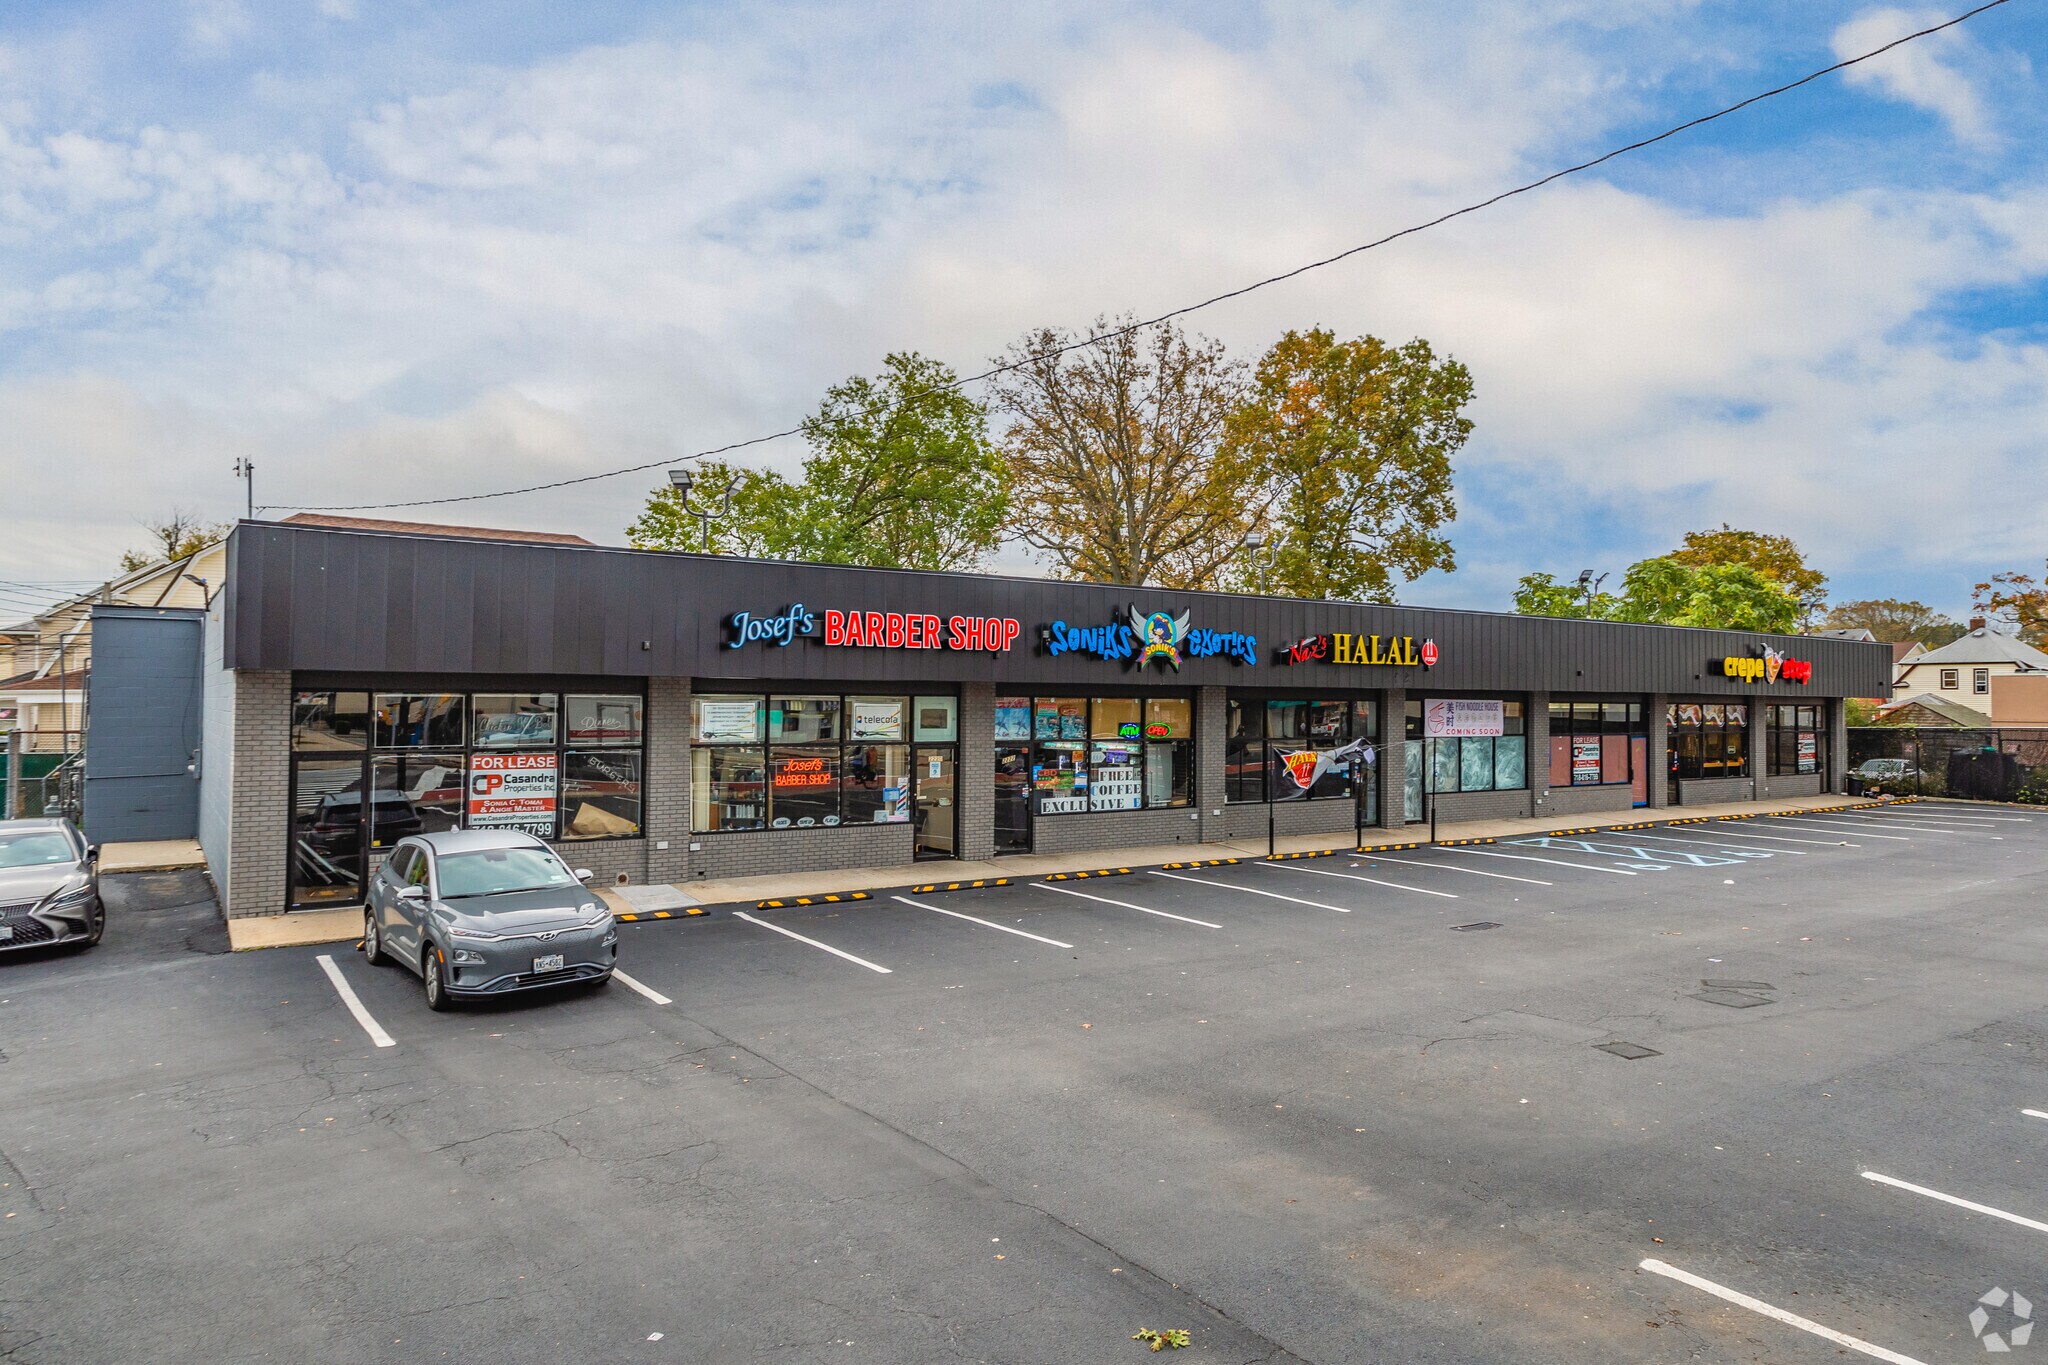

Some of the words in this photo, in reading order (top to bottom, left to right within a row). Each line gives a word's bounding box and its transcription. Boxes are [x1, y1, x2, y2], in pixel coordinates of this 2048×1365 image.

[728, 602, 814, 649] Josef's
[824, 609, 942, 649] BARBER
[948, 615, 1020, 652] SHOP
[1289, 634, 1327, 666] Naz's
[1332, 633, 1419, 666] HALAL
[1723, 656, 1765, 683] crepe
[1455, 702, 1465, 711] FISH
[1466, 702, 1483, 711] NOODLE
[1485, 702, 1499, 711] HOUSE
[864, 715, 899, 724] telecola
[1120, 726, 1139, 736] ATM
[1147, 725, 1168, 736] OPEN
[472, 757, 504, 769] FOR
[507, 756, 555, 768] LEASE
[783, 758, 823, 772] Josef's
[504, 773, 555, 784] Casandra
[589, 757, 637, 794] BURGERS
[775, 774, 807, 786] BARBER
[809, 773, 831, 785] SHOP
[1100, 770, 1132, 782] FREE
[504, 784, 542, 794] Properties
[1091, 783, 1141, 796] COFFEE
[473, 813, 553, 822] www.CasandraProperties.com
